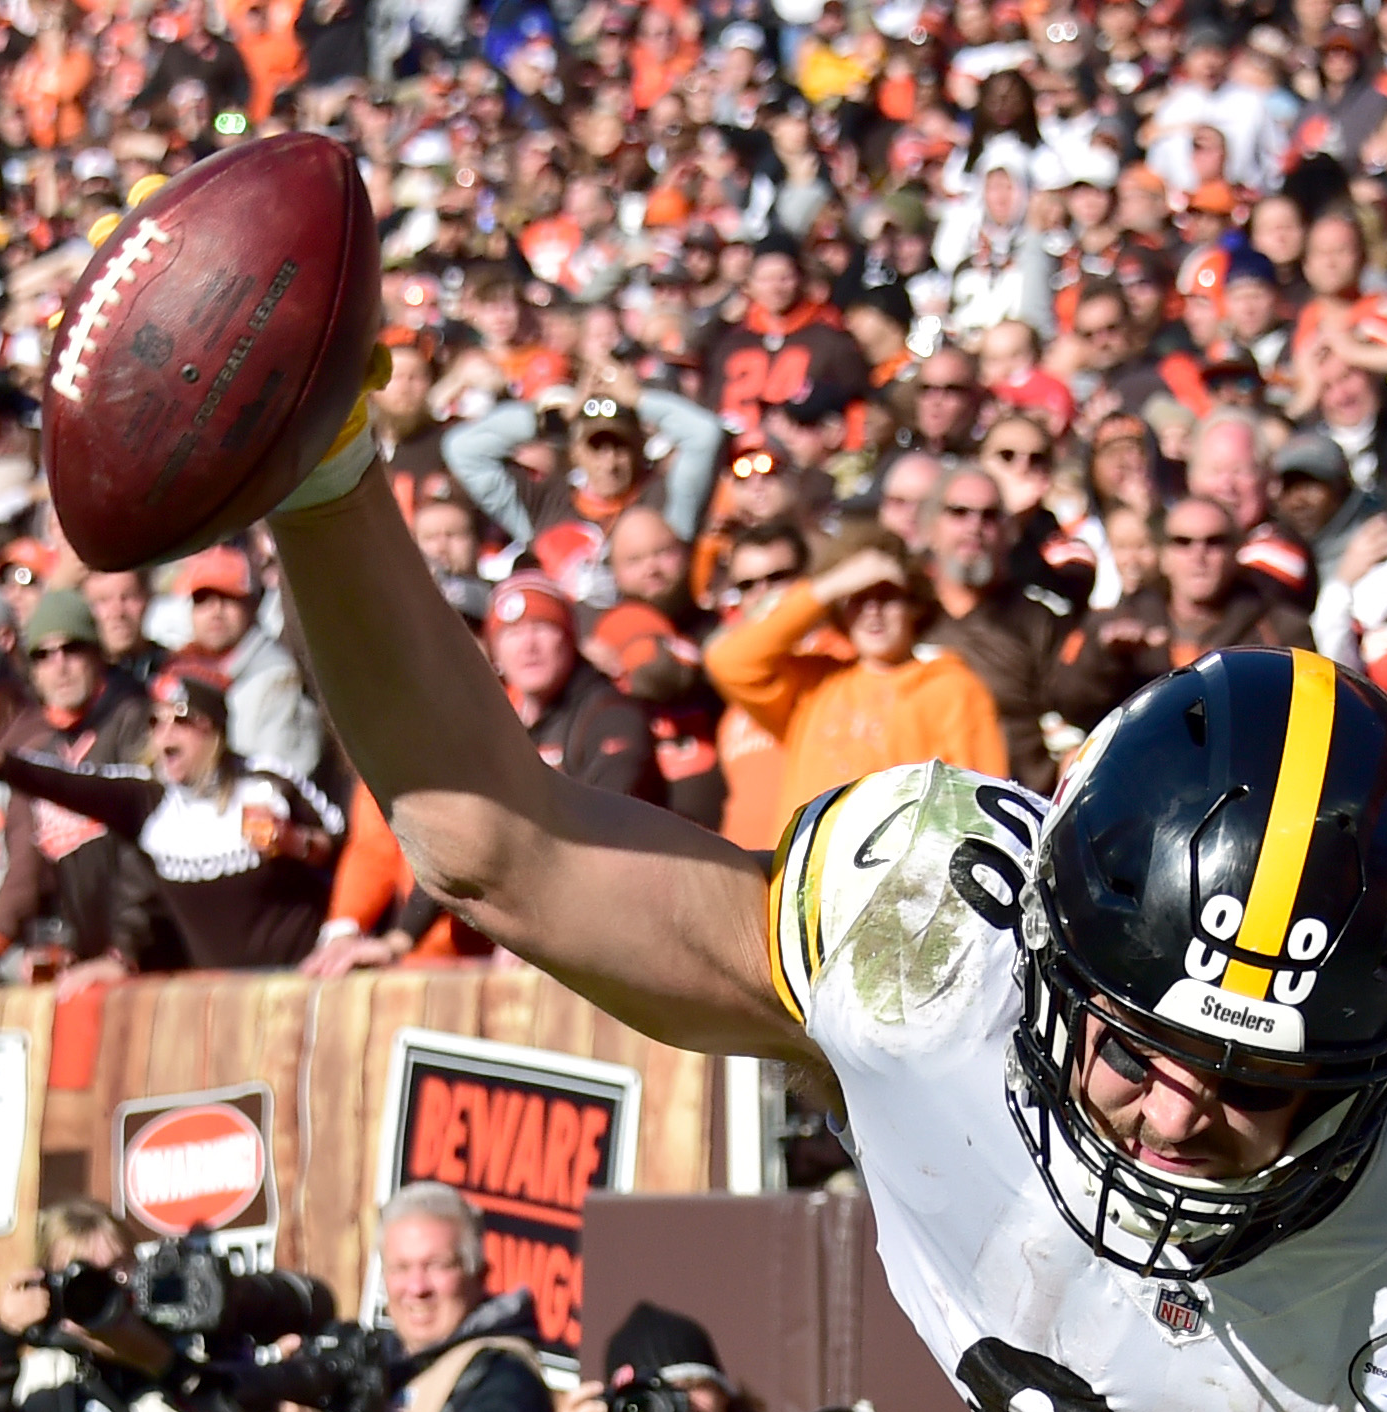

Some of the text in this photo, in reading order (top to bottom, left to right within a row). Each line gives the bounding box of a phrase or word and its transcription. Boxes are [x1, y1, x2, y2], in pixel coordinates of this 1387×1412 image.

[1184, 894, 1328, 1005] 88
[1200, 995, 1276, 1034] Steelers
[409, 1075, 610, 1208] BEWARE
[1160, 1302, 1194, 1330] NFL
